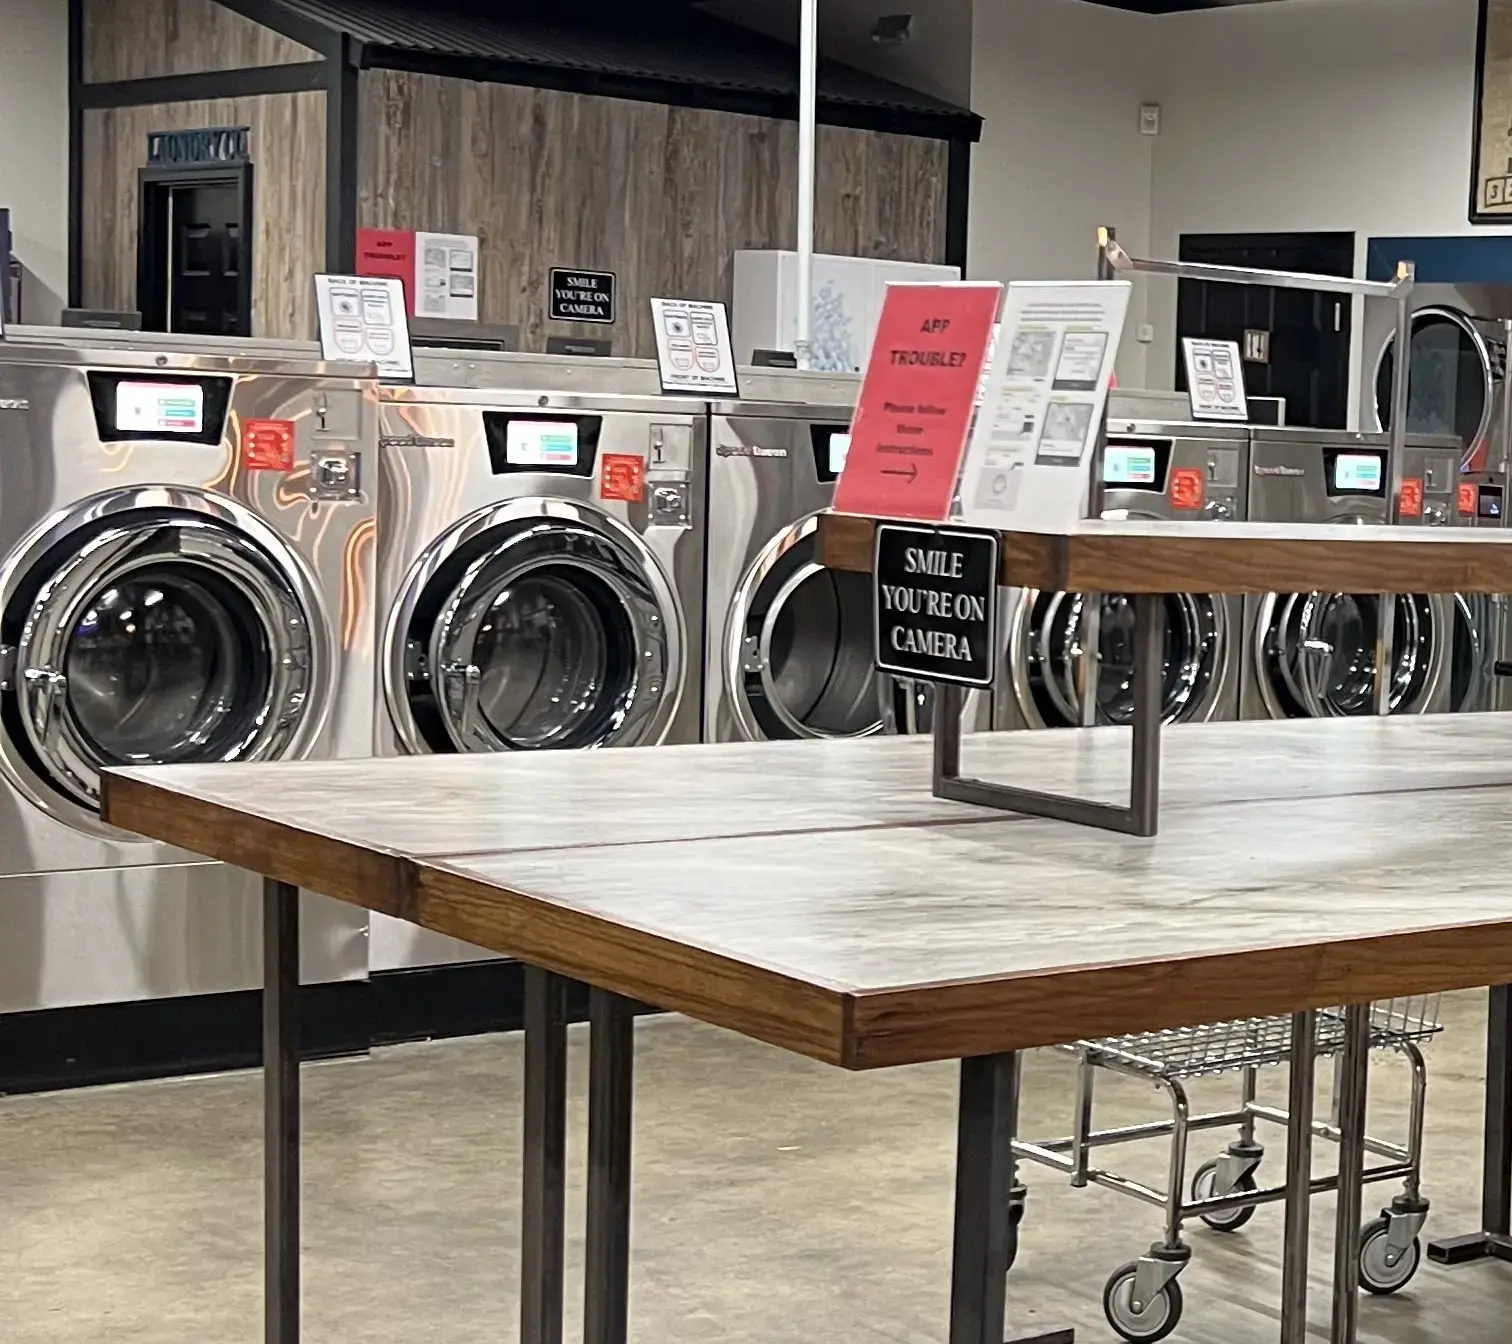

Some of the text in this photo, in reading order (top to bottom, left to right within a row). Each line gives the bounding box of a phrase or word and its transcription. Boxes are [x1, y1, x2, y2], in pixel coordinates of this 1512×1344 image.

[1490, 184, 1499, 199] 3
[566, 276, 598, 289] SMILE
[555, 289, 610, 303] YOU'RE ON
[560, 302, 604, 316] CAMERA
[890, 350, 967, 368] TROUBLE?
[904, 547, 964, 579] SMILE
[881, 584, 986, 623] YOU'RE ON
[890, 625, 974, 662] CAMERA
